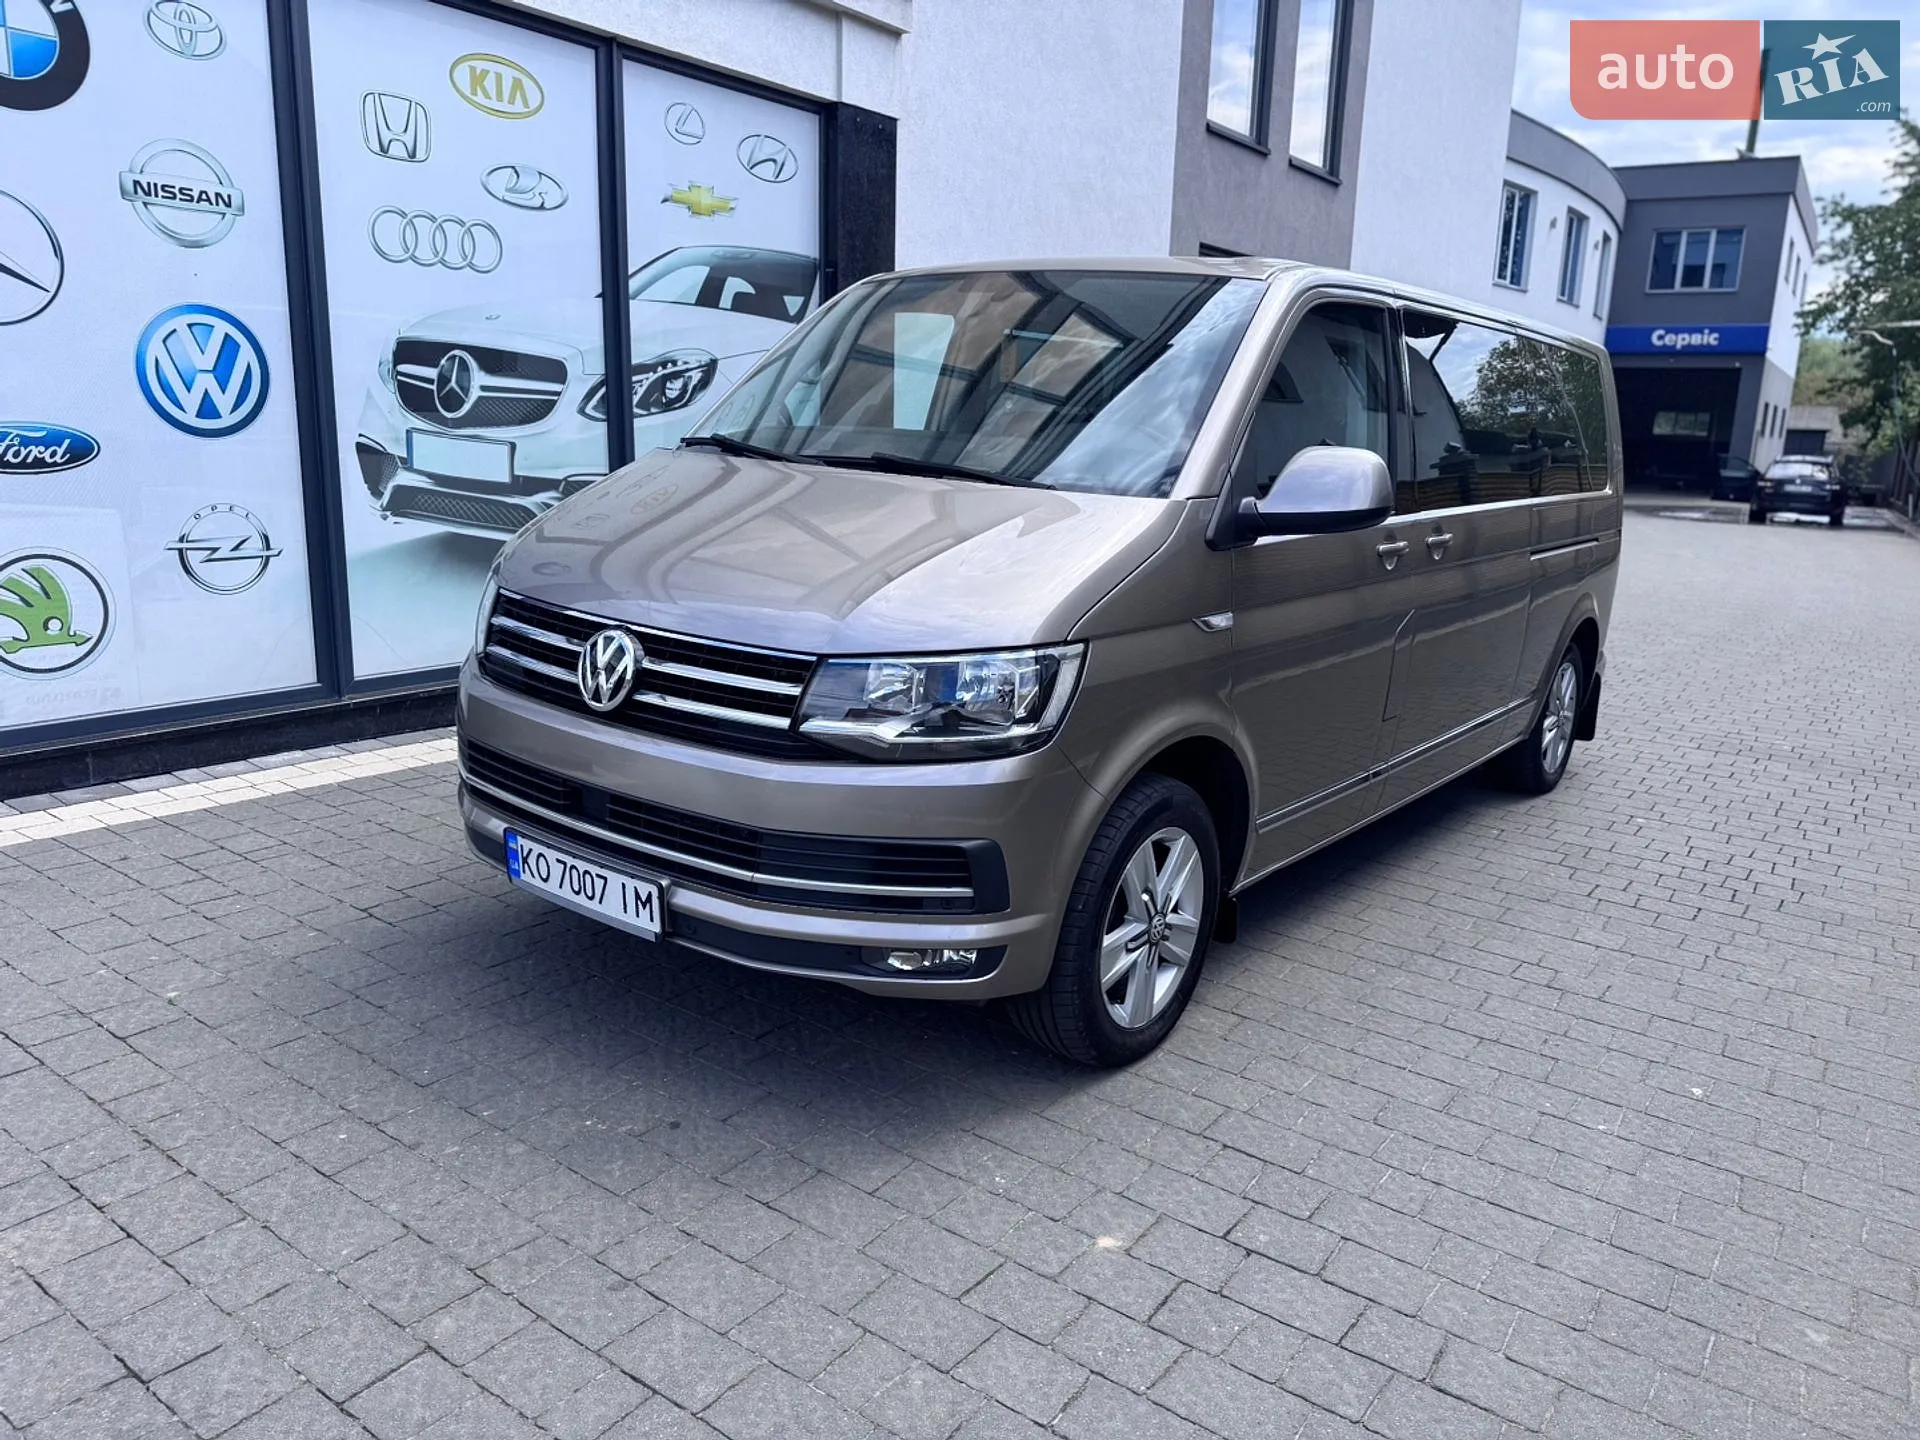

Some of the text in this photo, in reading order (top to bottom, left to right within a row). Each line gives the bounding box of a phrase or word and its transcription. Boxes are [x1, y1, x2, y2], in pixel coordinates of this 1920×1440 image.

[468, 64, 530, 109] KIA
[132, 179, 233, 209] NISSAN
[1651, 328, 1720, 350] Сервіс
[0, 429, 72, 463] Ford
[193, 504, 250, 520] OPEL
[555, 857, 608, 905] 7007
[621, 881, 655, 923] IM
